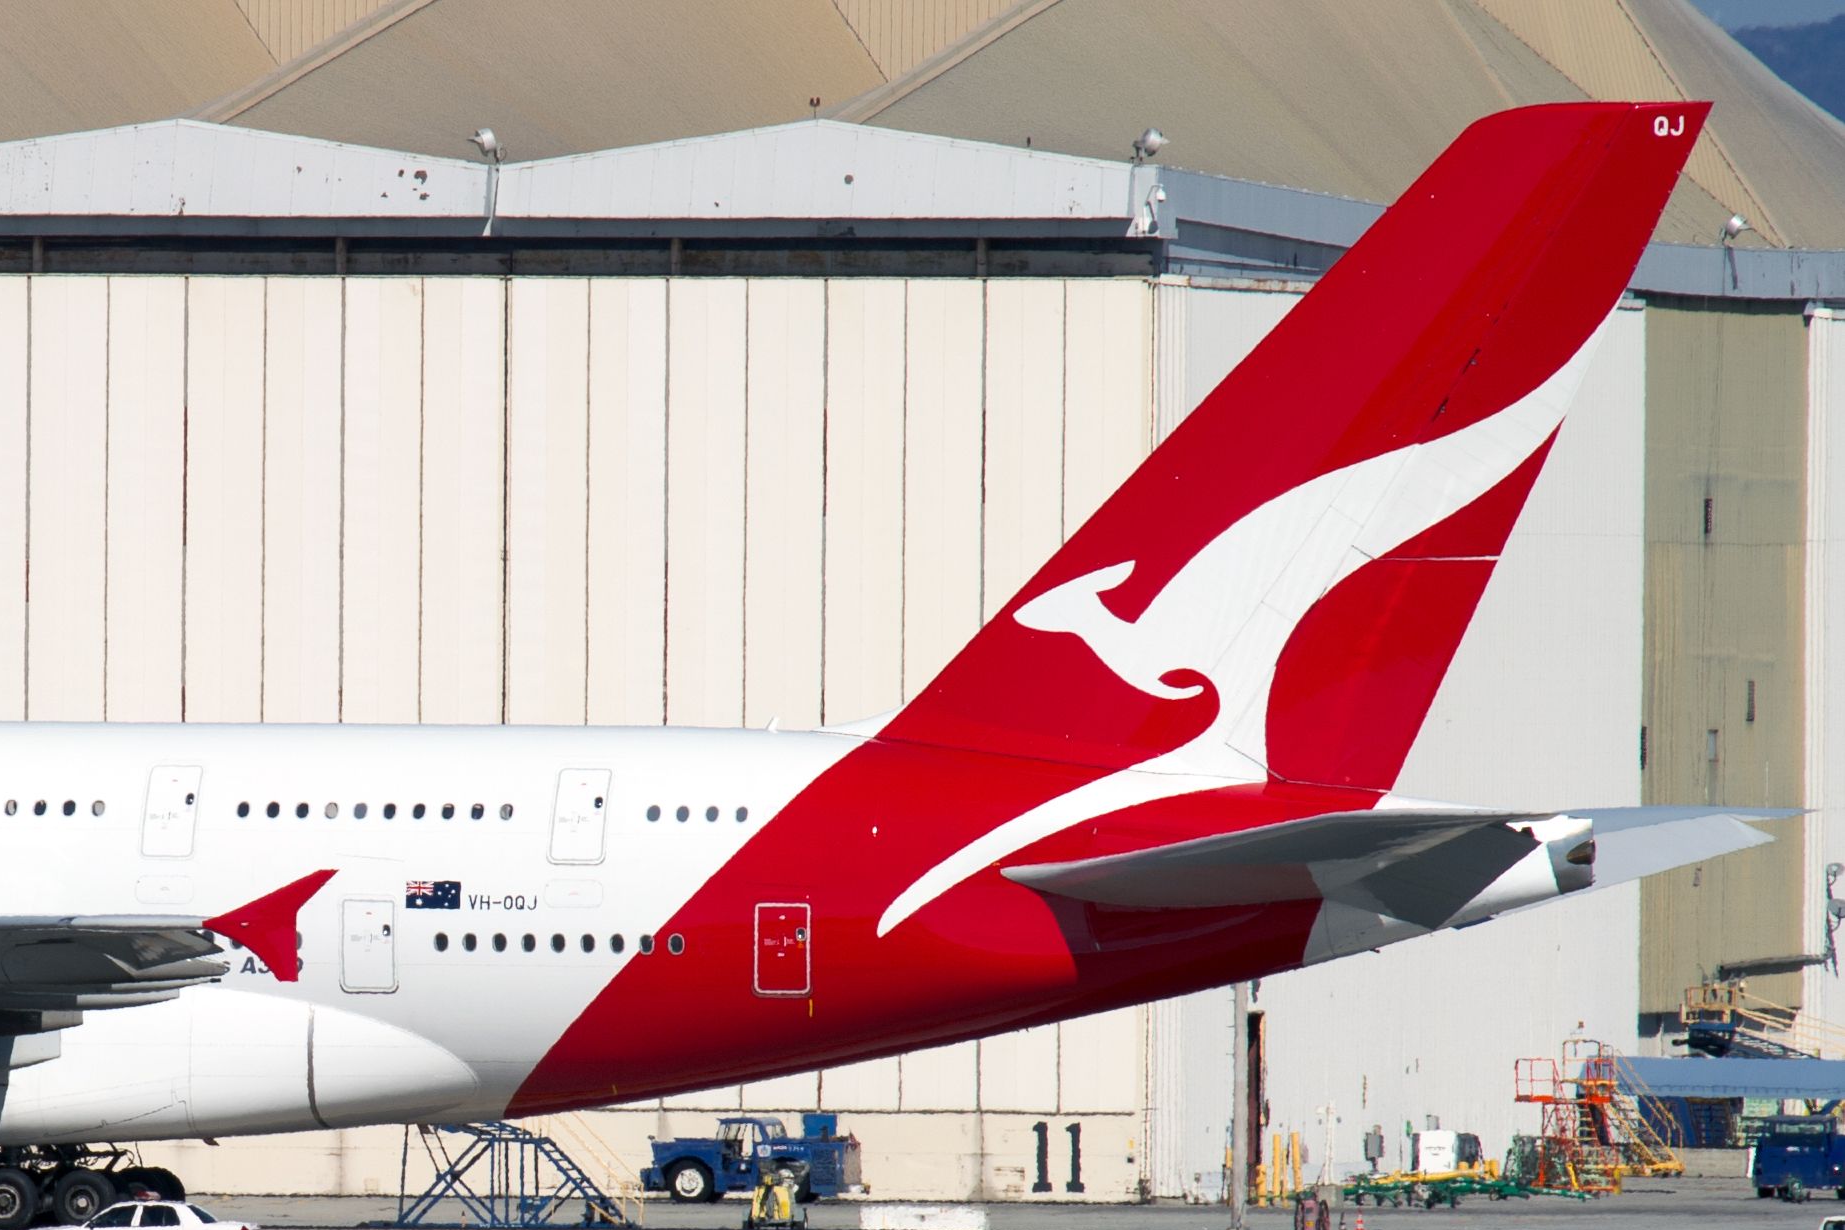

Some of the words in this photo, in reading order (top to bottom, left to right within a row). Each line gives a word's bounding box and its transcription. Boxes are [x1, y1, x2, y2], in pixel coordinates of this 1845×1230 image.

[1654, 116, 1685, 137] QJ
[468, 894, 538, 911] VH-OQJ
[1032, 1121, 1085, 1193] 11
